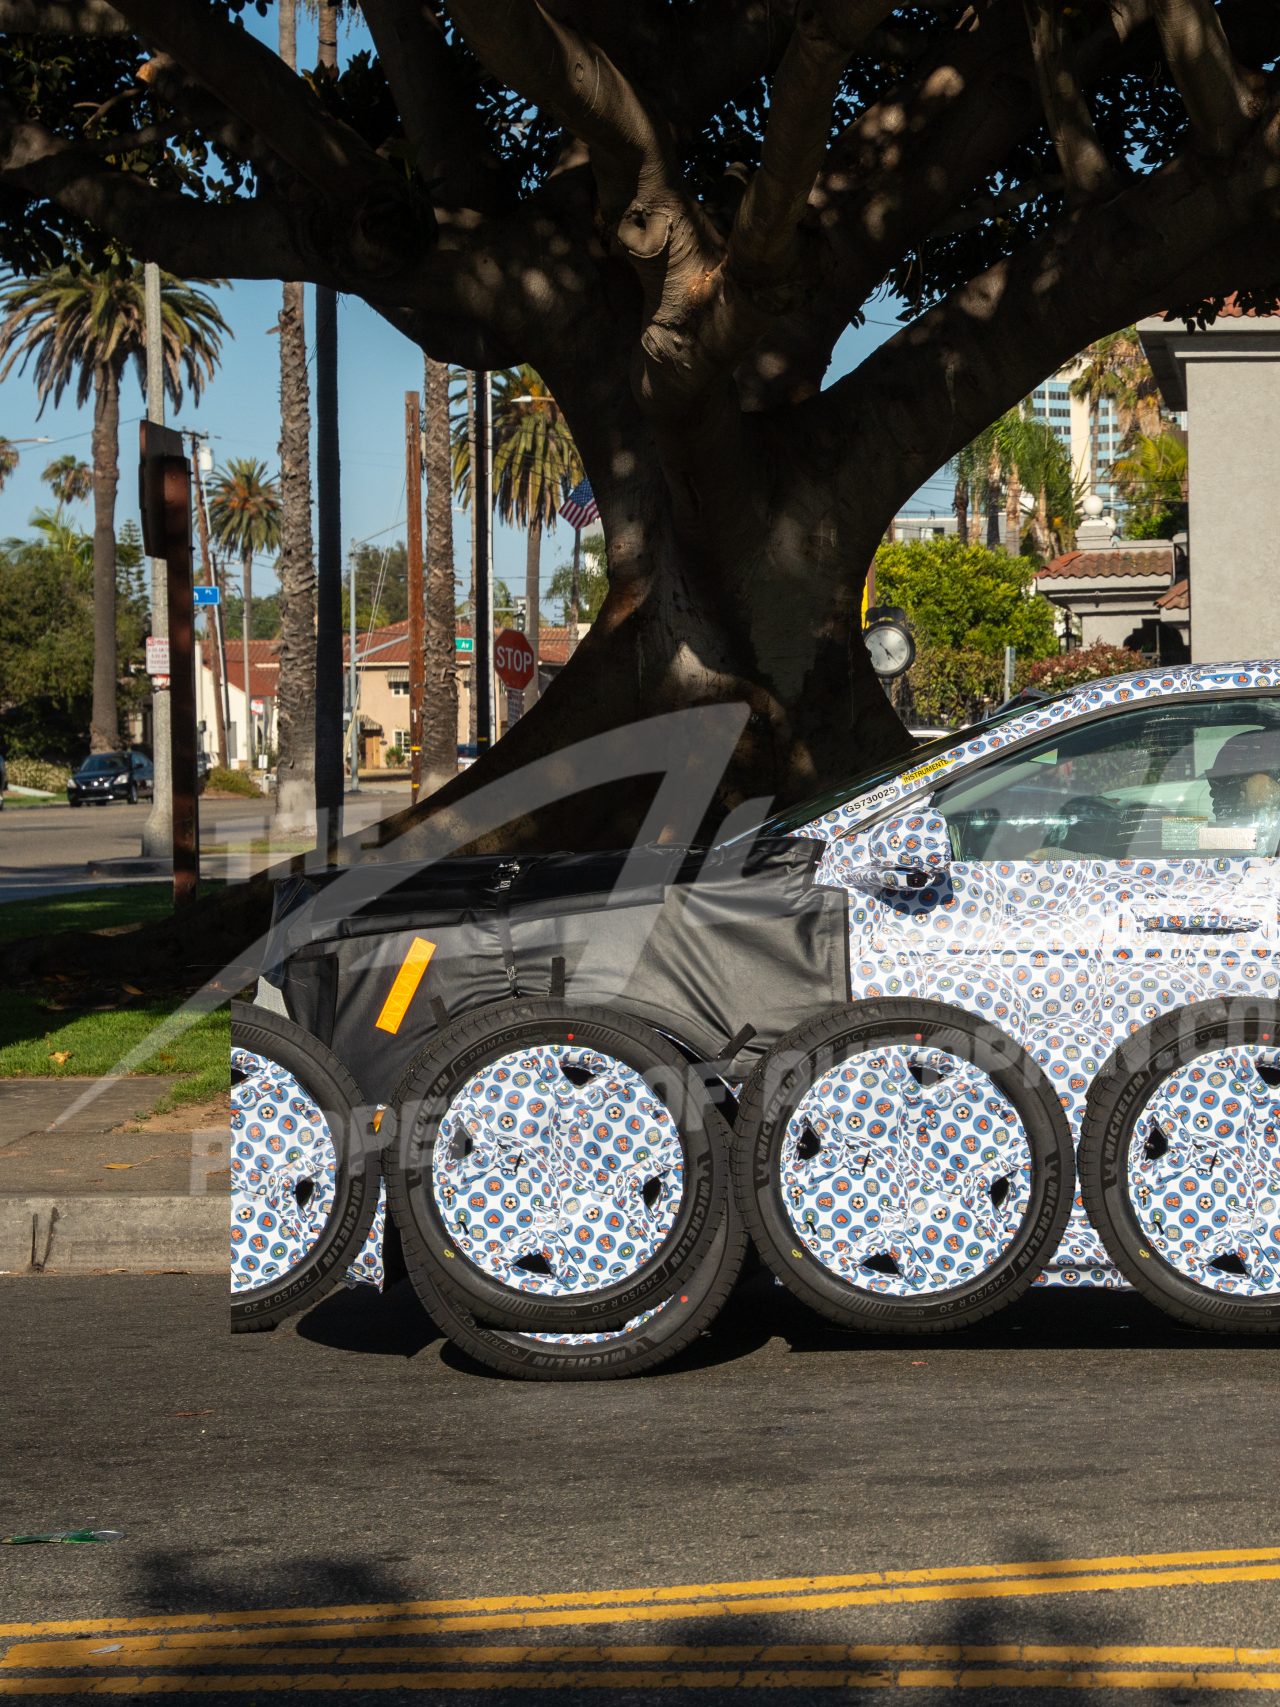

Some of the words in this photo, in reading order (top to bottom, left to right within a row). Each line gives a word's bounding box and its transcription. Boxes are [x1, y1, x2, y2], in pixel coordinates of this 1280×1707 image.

[496, 646, 532, 673] STOP
[846, 786, 896, 813] GS730025
[412, 1073, 450, 1162] MICHELIN
[760, 1073, 798, 1162] MICHELIN
[1108, 1073, 1146, 1162] MICHELIN
[321, 1180, 364, 1269] MICHELIN
[668, 1180, 711, 1269] MICHELIN
[1016, 1180, 1059, 1269] MICHELIN
[274, 1273, 314, 1302] 245/50
[621, 1273, 661, 1302] 245/50
[969, 1273, 1009, 1302] 245/50
[244, 1303, 260, 1313] 20
[591, 1303, 607, 1313] 20
[939, 1303, 955, 1313] 20
[531, 1349, 628, 1368] MICHELIN
